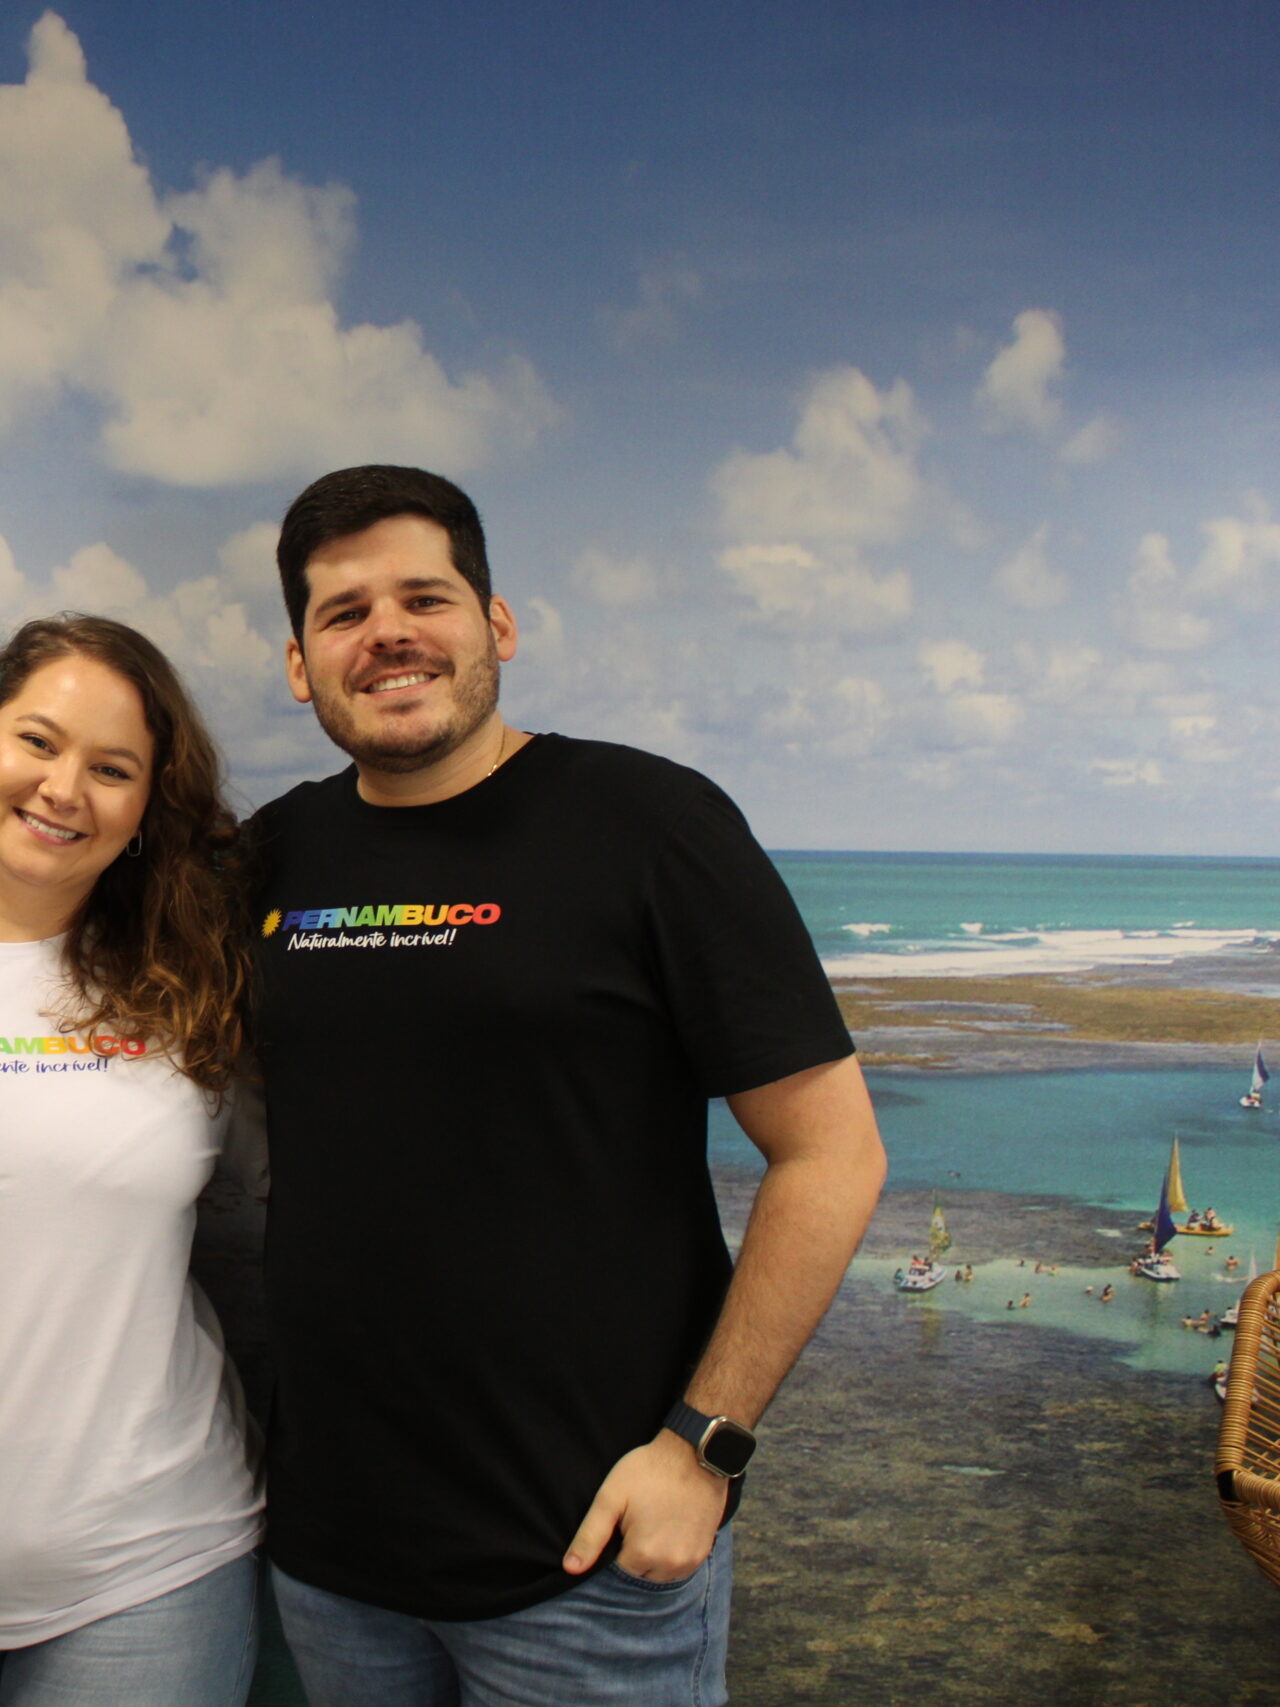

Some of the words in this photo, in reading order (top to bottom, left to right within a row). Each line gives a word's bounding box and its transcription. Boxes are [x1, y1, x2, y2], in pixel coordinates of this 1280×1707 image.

[282, 903, 501, 931] PERNAMBUCO
[287, 930, 386, 951] Naturalmente
[390, 928, 457, 947] incrível!
[36, 1057, 109, 1074] incrível!
